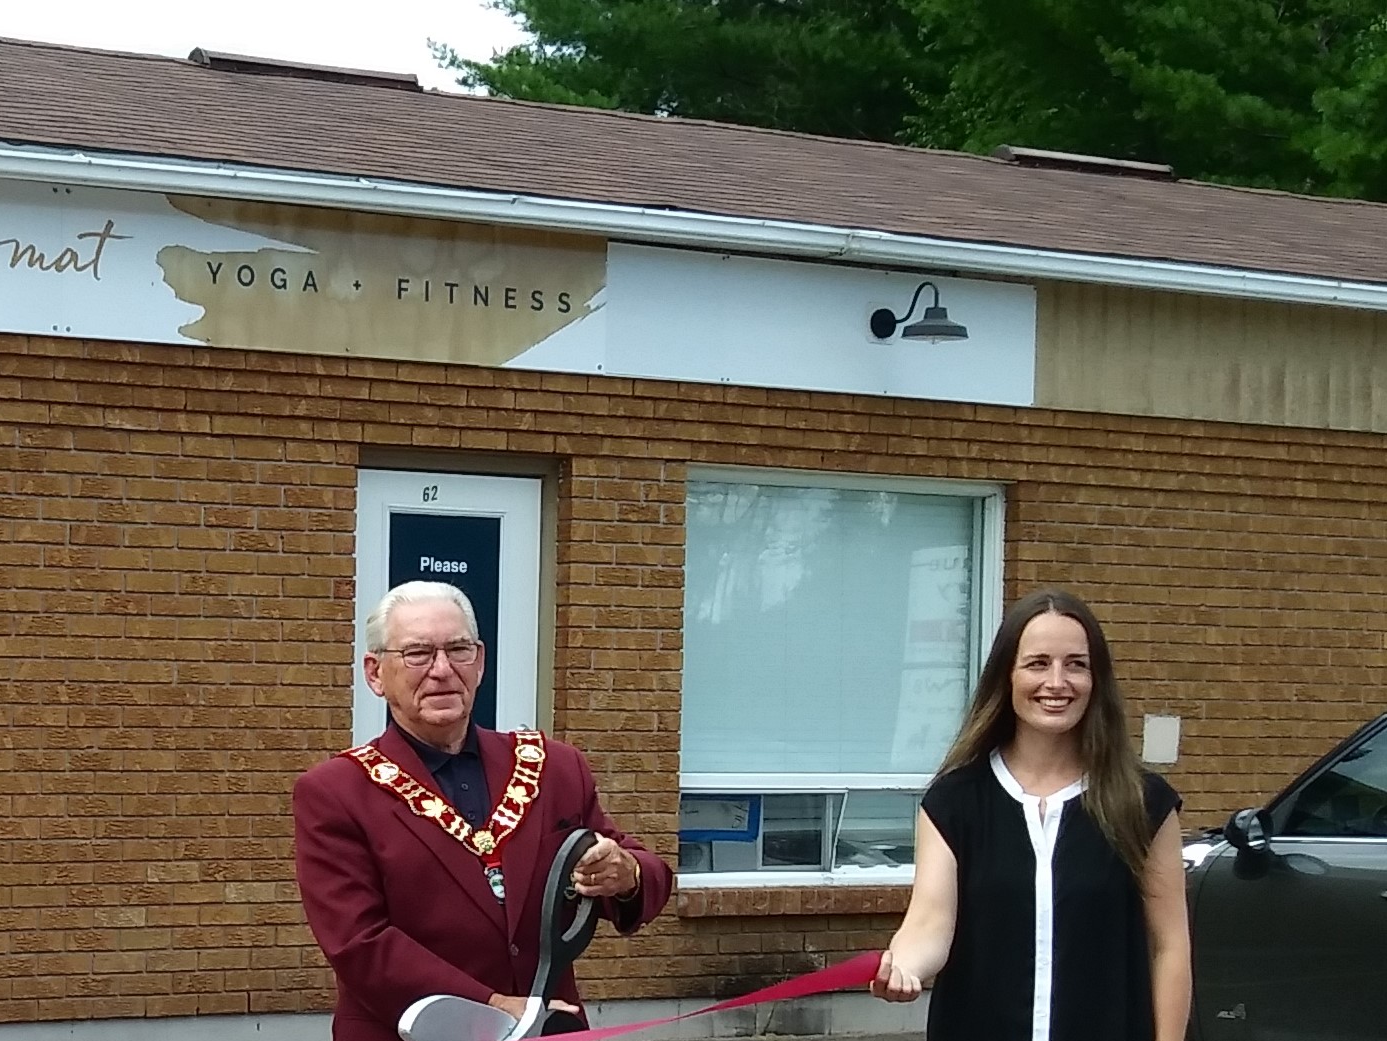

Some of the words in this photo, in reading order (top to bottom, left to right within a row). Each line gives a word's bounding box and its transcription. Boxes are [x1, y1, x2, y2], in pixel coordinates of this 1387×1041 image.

[206, 261, 320, 294] YOGA
[396, 278, 573, 314] FITNESS
[422, 485, 439, 502] 62
[420, 557, 468, 573] Please
